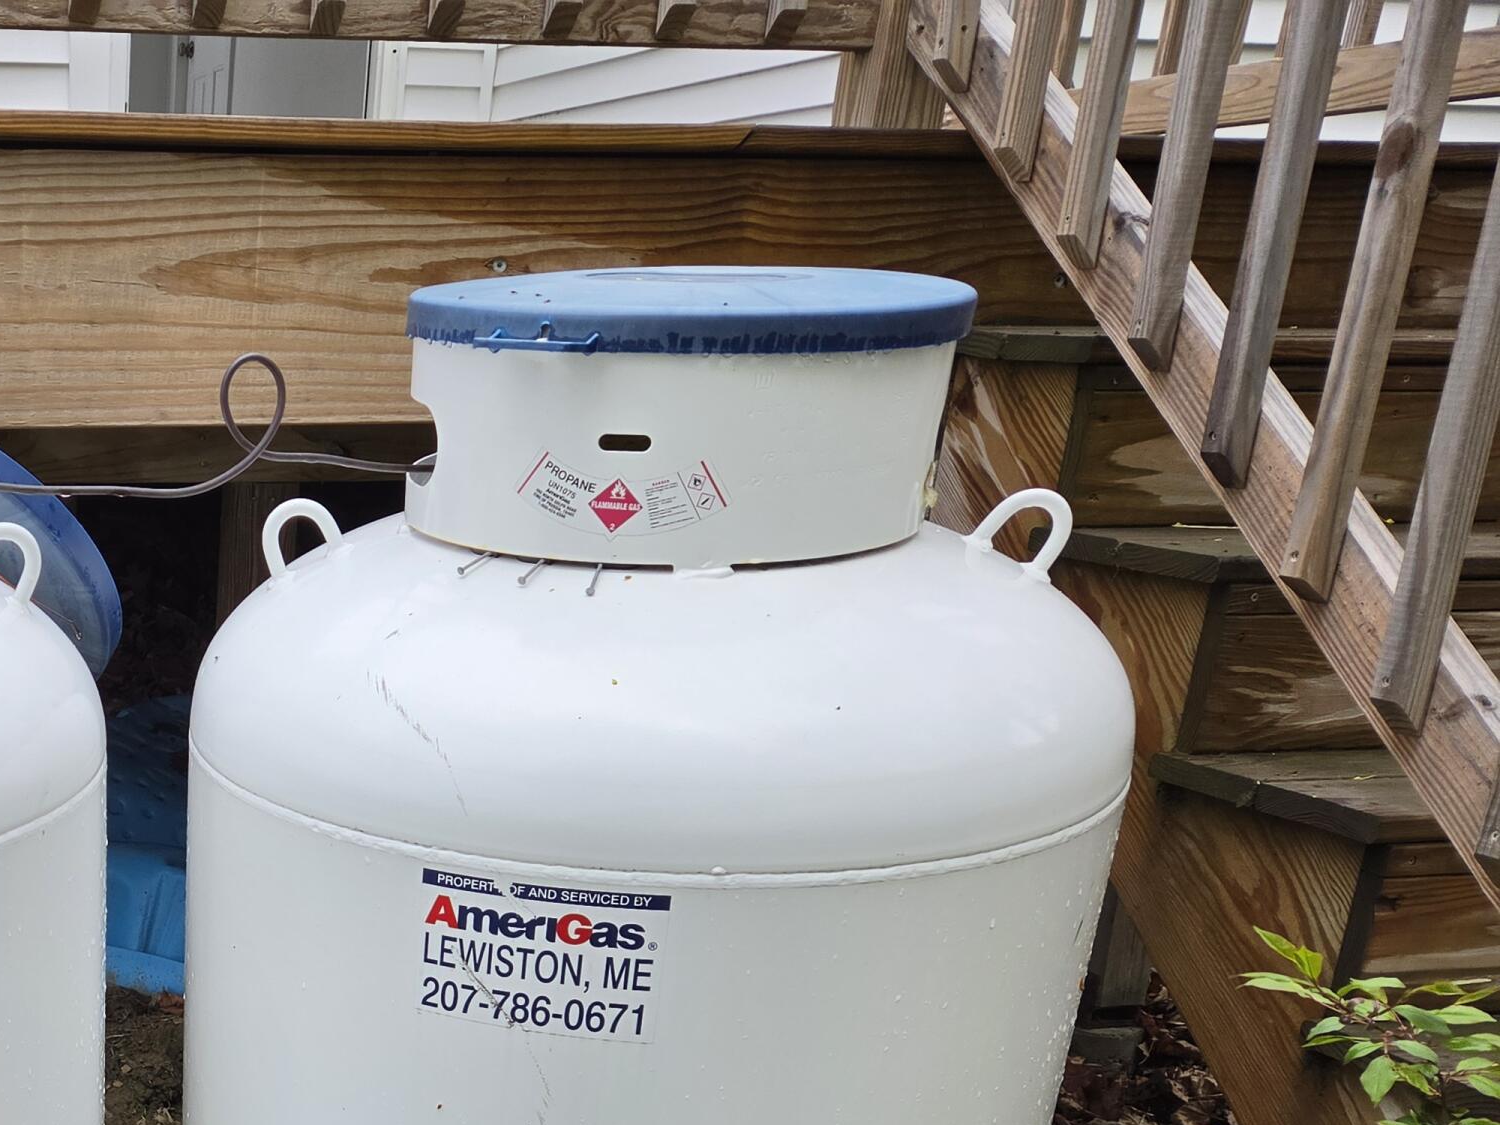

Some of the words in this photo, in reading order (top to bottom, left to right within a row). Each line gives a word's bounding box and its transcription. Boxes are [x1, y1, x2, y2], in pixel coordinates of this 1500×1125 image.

[545, 460, 596, 493] PROPANE
[548, 480, 576, 499] UN1075
[437, 873, 503, 893] PROPERT
[528, 887, 558, 902] AND
[561, 890, 630, 906] SERVICED
[633, 896, 652, 907] BY
[425, 895, 645, 950] AmeriGas
[423, 932, 591, 993] LEWISTON,
[603, 957, 654, 992] ME
[421, 976, 645, 1036] 207-786-0671
